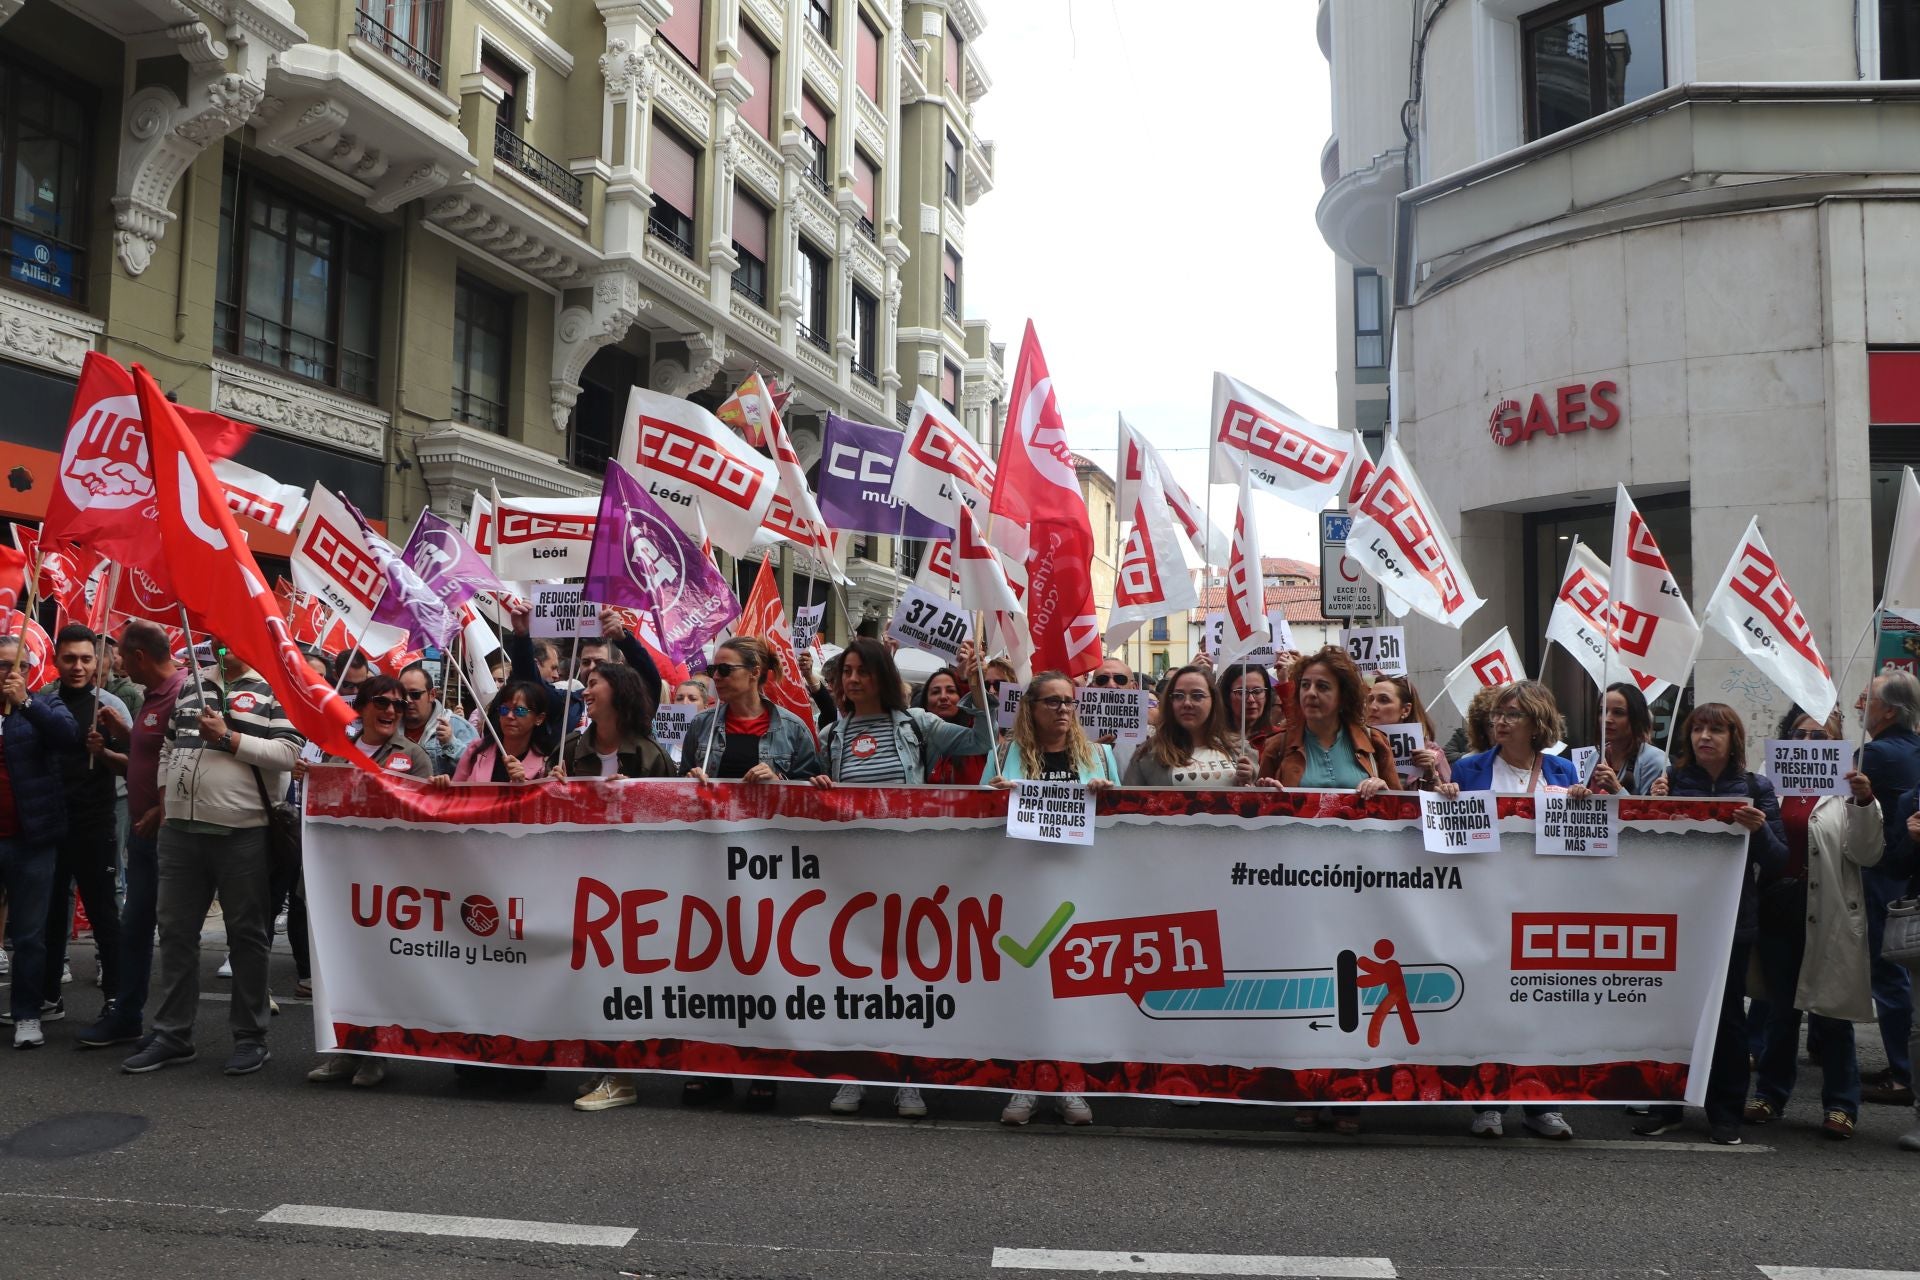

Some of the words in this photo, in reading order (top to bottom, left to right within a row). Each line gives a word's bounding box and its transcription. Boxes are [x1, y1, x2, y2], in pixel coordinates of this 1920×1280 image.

[21, 262, 61, 287] Allianz
[1489, 380, 1620, 447] GAES
[1228, 409, 1336, 475] CCOO
[641, 424, 755, 496] CCOO
[828, 442, 894, 483] CC
[650, 481, 693, 507] León
[1372, 478, 1460, 609] CCOO
[532, 546, 568, 559] León
[1370, 537, 1404, 580] León
[1660, 580, 1681, 598] Le
[321, 584, 352, 614] León
[536, 605, 548, 618] DE
[556, 618, 576, 632] ¡YA!
[905, 599, 968, 645] 37,5h
[899, 624, 929, 643] JUSTICIA
[929, 636, 959, 656] LABORAL
[1349, 635, 1400, 661] 37,5h
[1380, 661, 1401, 669] LABORAL
[1082, 692, 1098, 703] LOS
[1100, 690, 1126, 704] NIÑOS
[1128, 693, 1139, 705] DE
[1004, 702, 1017, 713] DE
[1080, 702, 1102, 715] PAPÁ
[1105, 705, 1139, 717] QUIEREN
[1098, 717, 1140, 729] TRABAJES
[1389, 733, 1417, 759] 5h
[1775, 747, 1808, 761] 37,5h
[1822, 748, 1840, 761] ME
[1774, 761, 1827, 775] PRESENTO
[1831, 763, 1838, 776] A
[1782, 776, 1835, 789] DIPUTADO
[1021, 785, 1039, 797] LOS
[1042, 784, 1070, 800] NIÑOS
[1073, 788, 1085, 800] DE
[1019, 797, 1043, 811] PAPÁ
[1046, 800, 1086, 814] QUIEREN
[1426, 796, 1486, 816] REDUCCIÓN
[1547, 798, 1563, 810] LOS
[1595, 799, 1607, 811] DE
[1017, 810, 1035, 823] QUE
[1038, 813, 1086, 827] TRABAJES
[1426, 815, 1437, 830] DE
[1438, 815, 1491, 831] JORNADA
[1545, 809, 1568, 823] PAPÁ
[1571, 812, 1608, 825] QUIEREN
[1039, 823, 1062, 838] MÁS
[1445, 831, 1468, 847] ¡YA!
[1544, 825, 1561, 837] QUE
[1563, 826, 1609, 839] TRABAJES
[1565, 836, 1586, 852] MÁS
[727, 846, 784, 881] Por
[791, 845, 821, 880] la
[1230, 862, 1464, 893] #reducciónjornadaYA
[351, 883, 451, 932] UGT
[570, 876, 1004, 984] REDUCCIÓN
[1521, 924, 1667, 960] CCOO
[389, 937, 460, 960] Castilla
[465, 945, 477, 966] y
[482, 944, 527, 965] León
[1510, 973, 1598, 987] comisiones
[1602, 973, 1664, 988] obreras
[1509, 988, 1528, 1003] de
[1532, 988, 1590, 1003] Castilla
[1594, 991, 1603, 1005] y
[1607, 989, 1647, 1003] León
[602, 985, 653, 1021] del
[662, 985, 777, 1029] tiempo
[785, 985, 827, 1021] de
[834, 984, 957, 1029] trabajo
